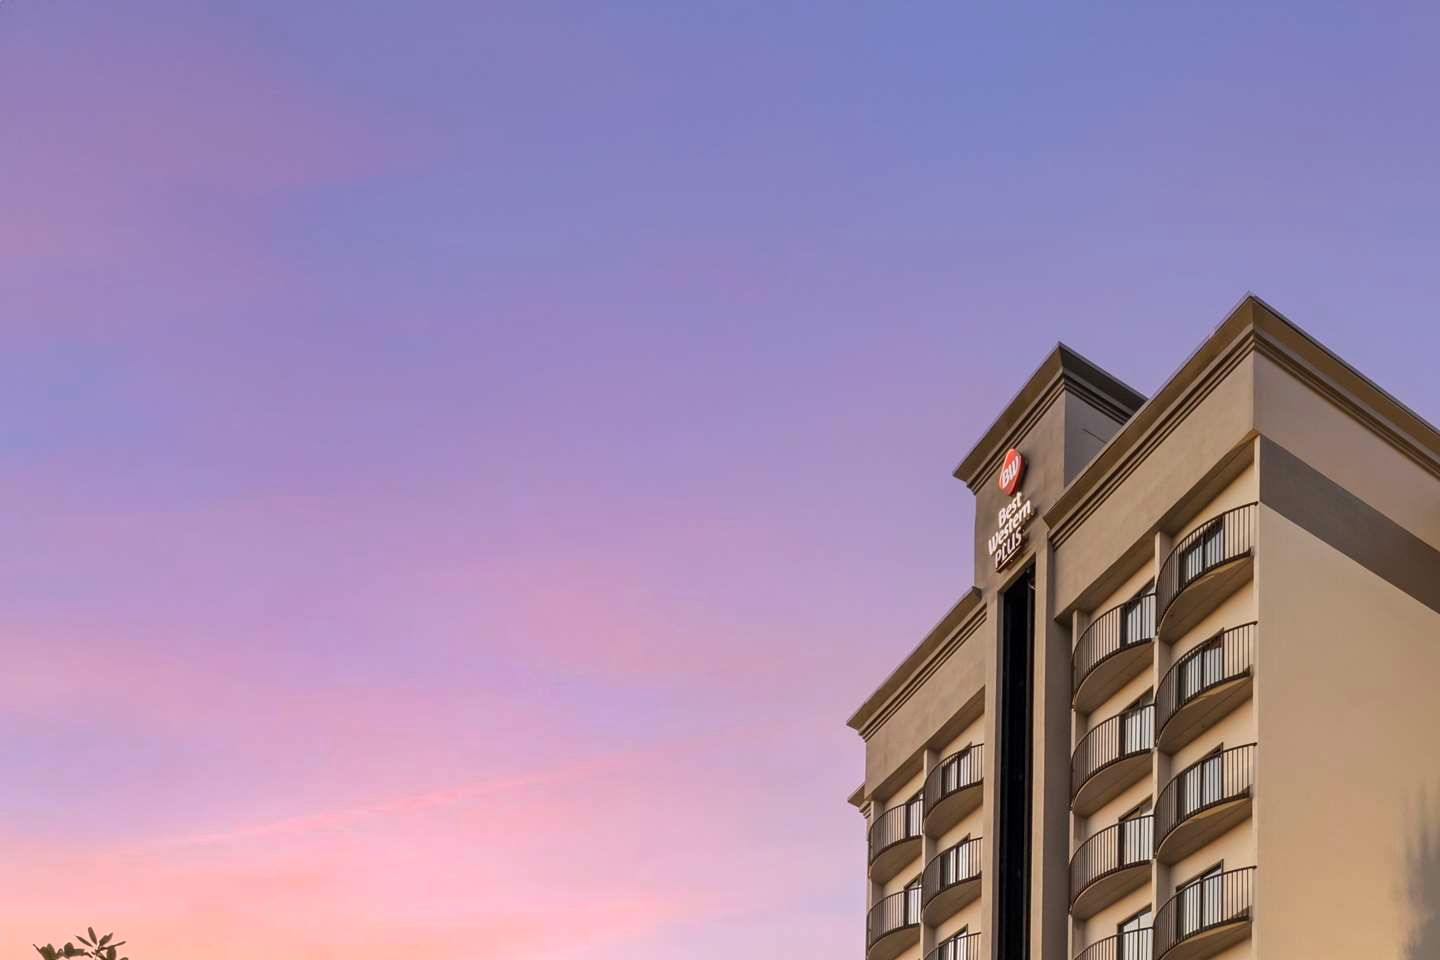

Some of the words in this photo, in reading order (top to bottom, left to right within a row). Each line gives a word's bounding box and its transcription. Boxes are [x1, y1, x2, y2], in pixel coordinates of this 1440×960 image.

[1001, 455, 1022, 488] BW
[988, 500, 1031, 555] Western
[998, 492, 1022, 528] Best
[994, 527, 1022, 569] PLUS
